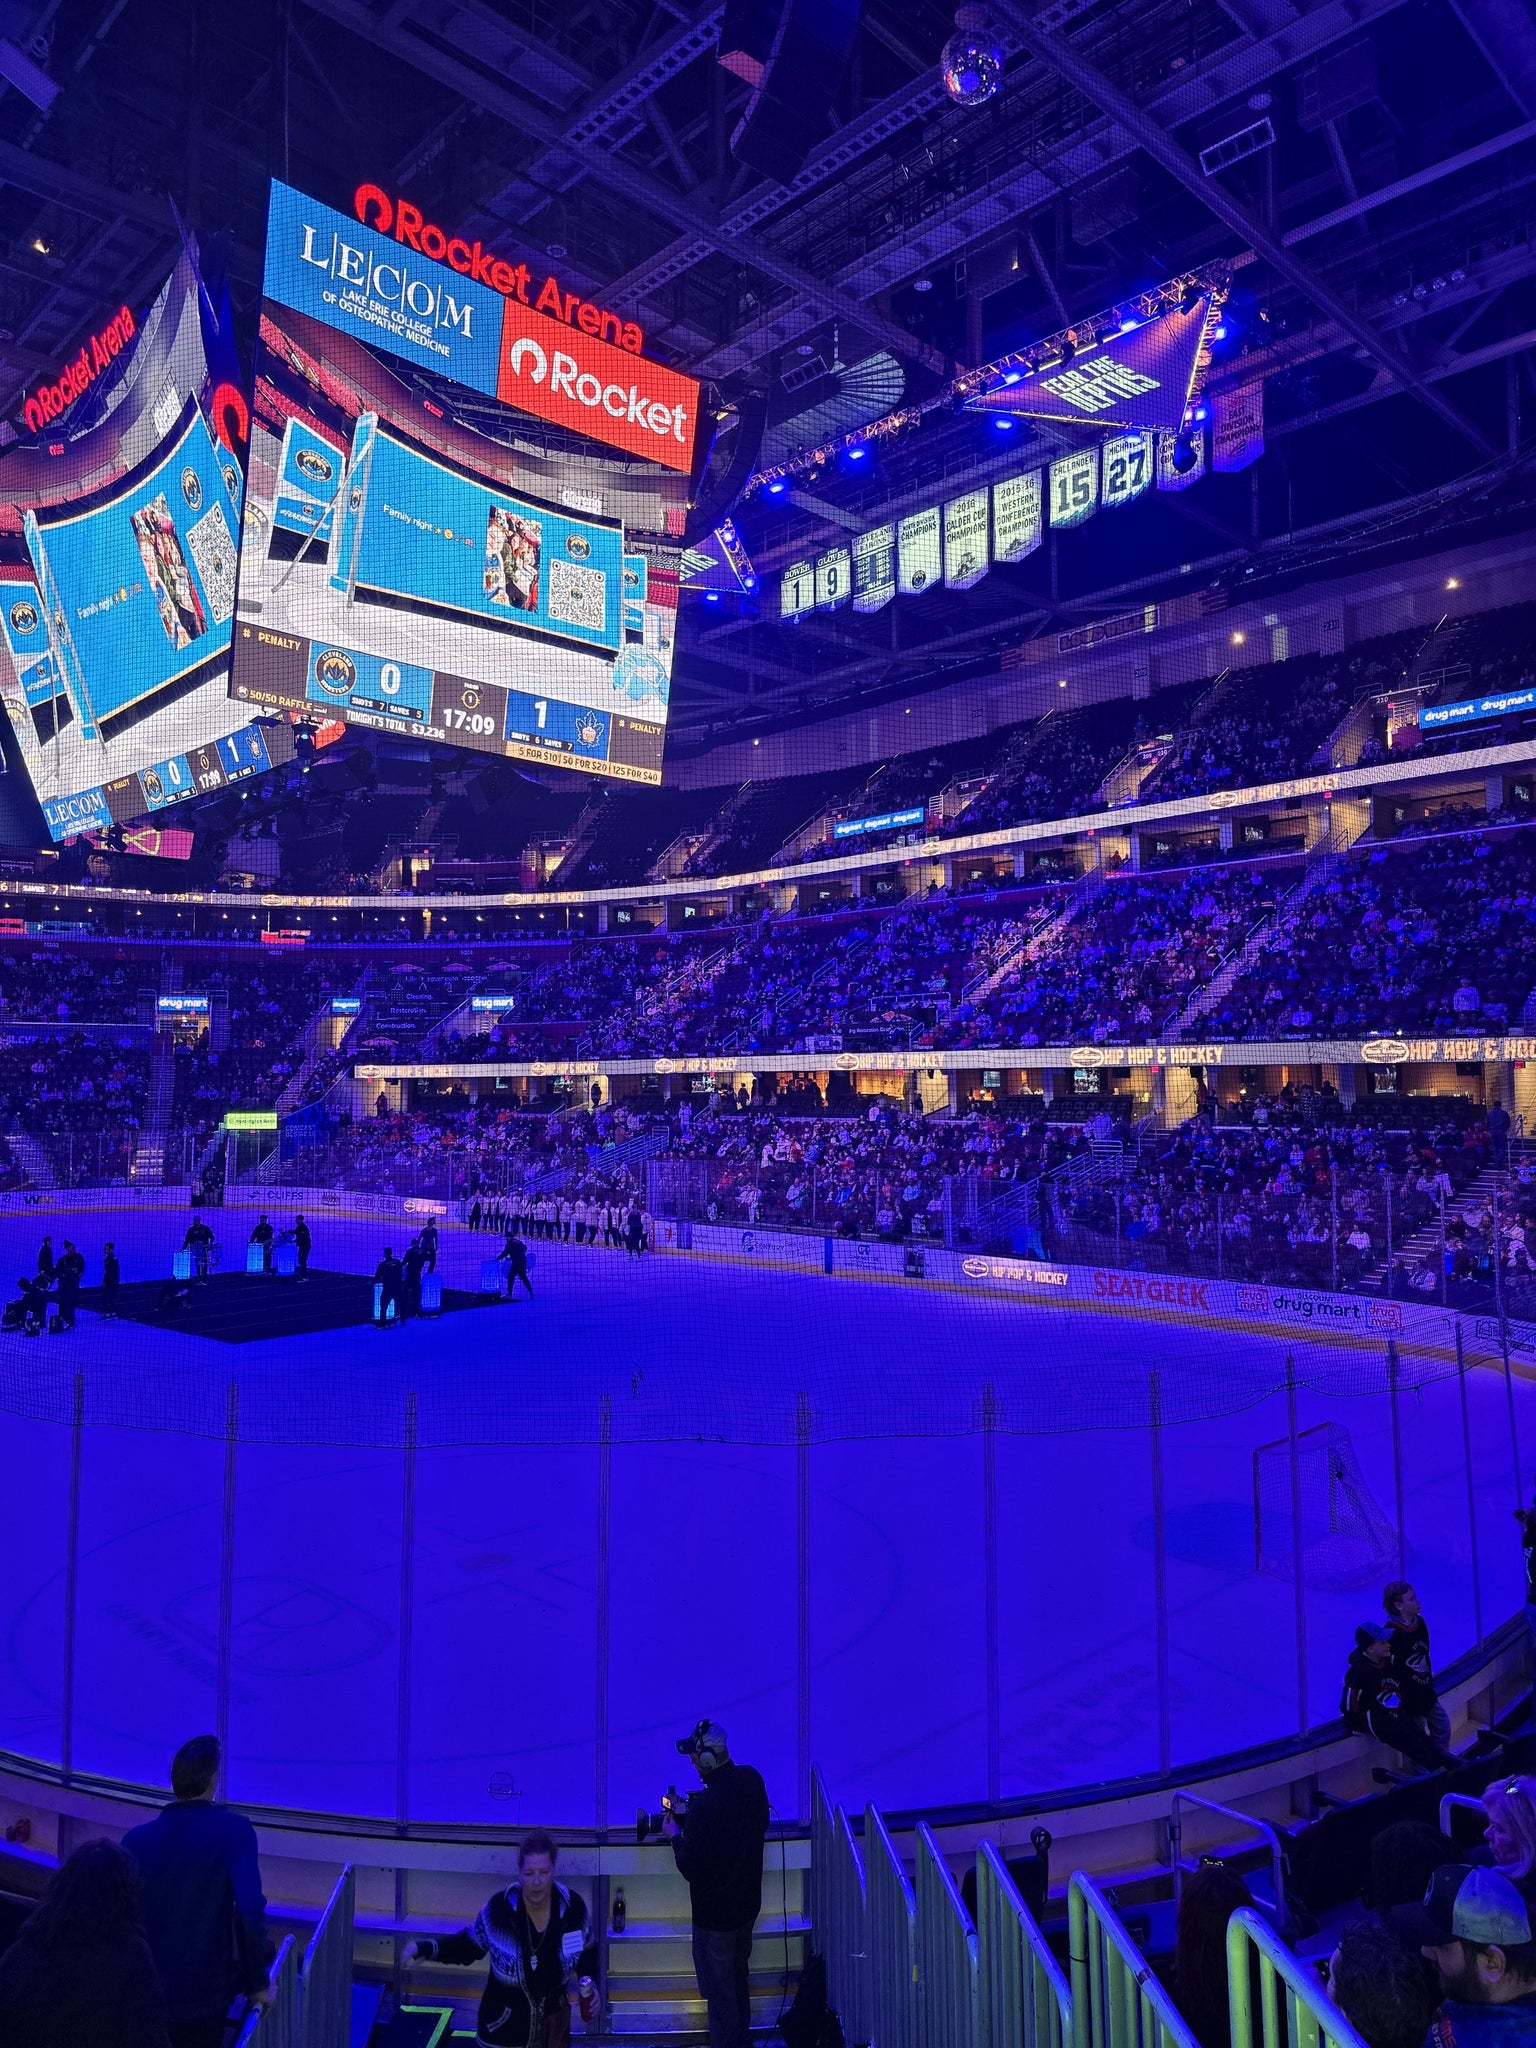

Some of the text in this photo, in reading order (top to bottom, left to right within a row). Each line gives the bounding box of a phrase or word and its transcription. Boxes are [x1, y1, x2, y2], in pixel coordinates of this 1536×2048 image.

[395, 199, 643, 353] Rocket Arena
[342, 287, 432, 337] LAKE ERIE COLLEGE
[322, 290, 450, 358] OF OSTEOPATHIC MEDICINE
[37, 305, 135, 422] Rocket Arena
[1040, 355, 1120, 395] FEAR THE
[550, 351, 687, 443] Rocket
[1059, 365, 1161, 414] DEPTHS
[1229, 405, 1247, 420] EAST
[1215, 423, 1260, 445] CHAMPIONS
[1220, 415, 1254, 433] DIVISION
[1053, 455, 1094, 477] CALLANDER
[1109, 449, 1147, 496] 27
[1001, 478, 1035, 500] 2015-16
[1057, 470, 1091, 513] 15
[382, 503, 412, 525] Family
[997, 502, 1040, 526] CONFERENCE
[1001, 493, 1034, 513] WESTERN
[900, 521, 937, 542] CHAMPIONS
[946, 514, 972, 532] CALDER
[946, 520, 986, 544] CHAMPIONS
[998, 515, 1038, 537] CHAMPIONS
[817, 548, 849, 567] GLOVER
[784, 563, 811, 580] BOWER
[827, 567, 838, 596] 9
[793, 580, 800, 609] 1
[257, 632, 301, 651] PENALTY
[380, 663, 401, 695] 0
[249, 689, 313, 713] 50/50 RAFFLE
[1424, 693, 1533, 721] drug mart drug mart
[346, 710, 384, 728] TONIGHT'S
[385, 718, 407, 733] TOTAL
[411, 722, 446, 740] $3,236
[415, 709, 423, 719] 5
[443, 708, 496, 736] 17:09
[534, 700, 548, 729] 1
[629, 721, 662, 736] PENALTY
[226, 736, 240, 763] 1
[167, 760, 182, 786] 0
[519, 746, 659, 782] 5 FOR $10 50 FOR $20 125 FOR $40
[198, 769, 222, 790] 17:09
[1237, 786, 1259, 803] HIP
[1260, 782, 1282, 799] HOP
[1297, 774, 1340, 794] HOCKEY
[52, 885, 60, 895] 7
[172, 893, 189, 901] 7:51
[558, 891, 584, 902] HOCKEY
[159, 999, 208, 1009] drug mart
[472, 998, 514, 1009] drug mart
[859, 1054, 875, 1068] HIP
[876, 1054, 895, 1068] HOP
[907, 1053, 945, 1067] HOCKEY
[1104, 1046, 1224, 1065] HIP HOP & HOCKEY
[1409, 1040, 1498, 1060] HIP HOP &
[557, 1063, 570, 1074] HOP
[576, 1062, 598, 1074] HOCKEY
[674, 1060, 686, 1072] HIP
[687, 1059, 700, 1072] HOP
[709, 1057, 738, 1071] HOCKEY
[267, 1191, 303, 1201] CLIFFS
[992, 1266, 1007, 1279] HIP
[1007, 1268, 1024, 1281] HOP
[1034, 1271, 1068, 1286] HOCKEY
[1093, 1271, 1210, 1310] SEATGEEK
[1237, 1288, 1263, 1302] drug
[1273, 1295, 1361, 1319] drug mart
[1369, 1303, 1396, 1319] drug
